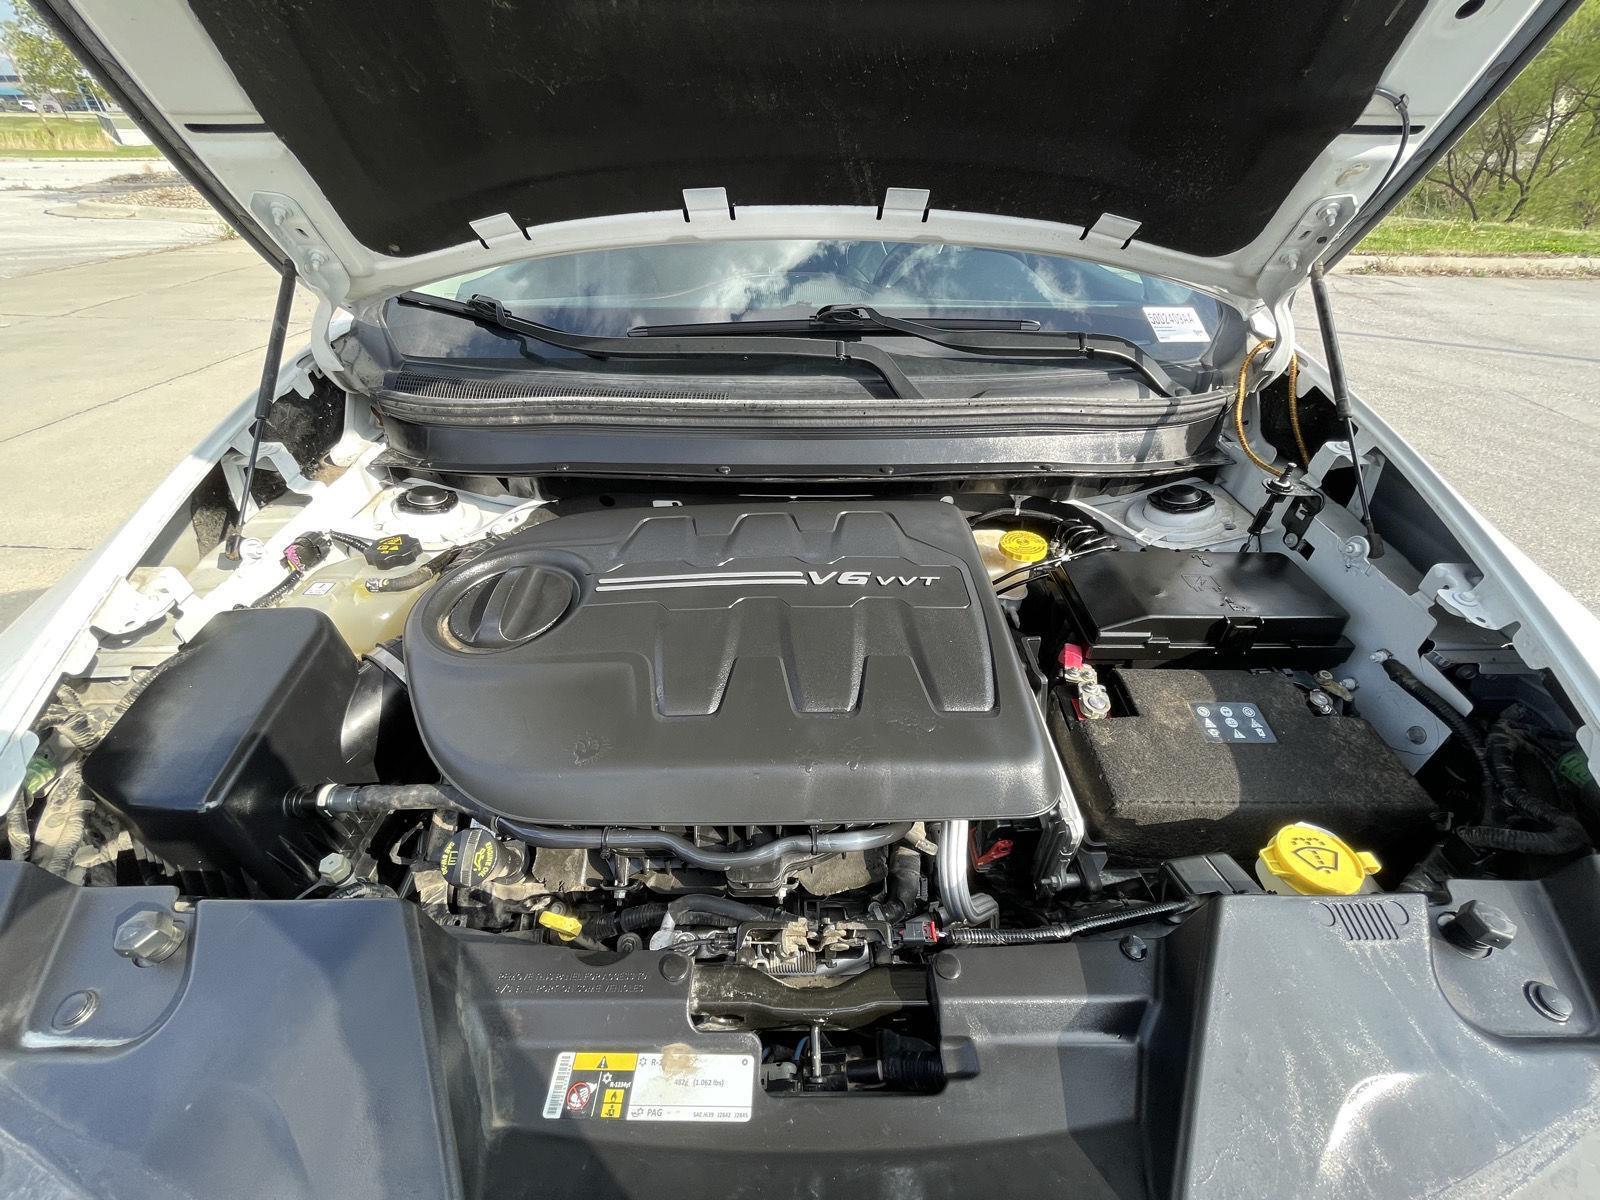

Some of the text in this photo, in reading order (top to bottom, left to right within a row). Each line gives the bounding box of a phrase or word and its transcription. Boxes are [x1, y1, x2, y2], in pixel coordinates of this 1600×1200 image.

[808, 571, 941, 586] V6 VVT
[478, 841, 494, 877] ENGINE OIL
[646, 1108, 663, 1117] PAG
